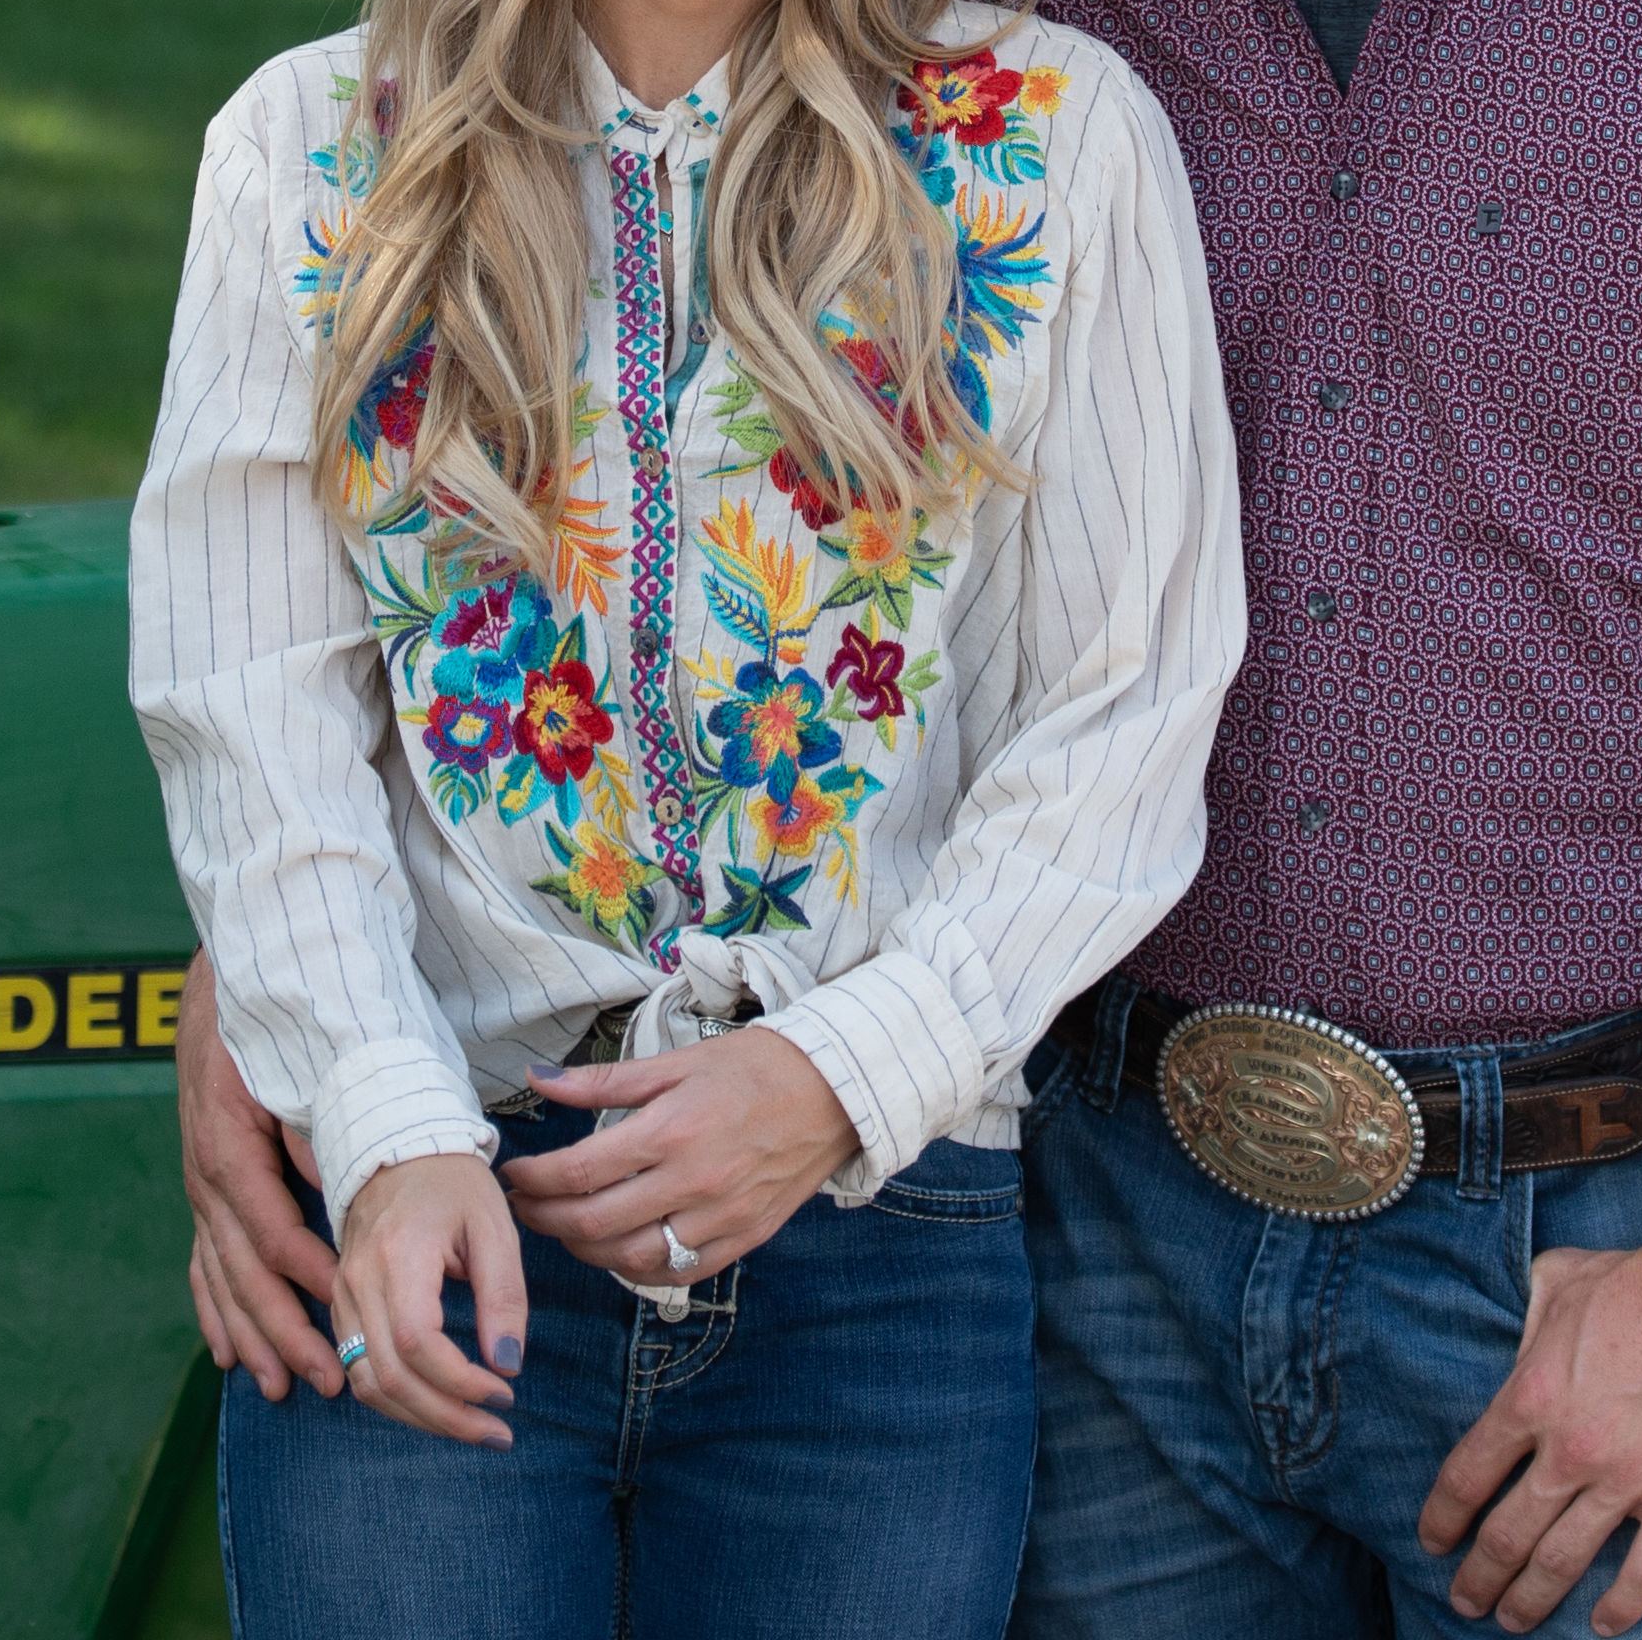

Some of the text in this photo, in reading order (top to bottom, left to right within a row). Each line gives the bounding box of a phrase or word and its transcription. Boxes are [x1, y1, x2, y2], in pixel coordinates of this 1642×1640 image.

[1209, 1020, 1263, 1036] RODEO
[1267, 1024, 1351, 1063] COWBOYS
[1248, 1060, 1307, 1082] WORLD
[1231, 1090, 1322, 1123] CHAMPION
[1259, 1131, 1329, 1152] AROUND
[1251, 1160, 1322, 1182] COWBOY
[1265, 1187, 1337, 1205] COOPER
